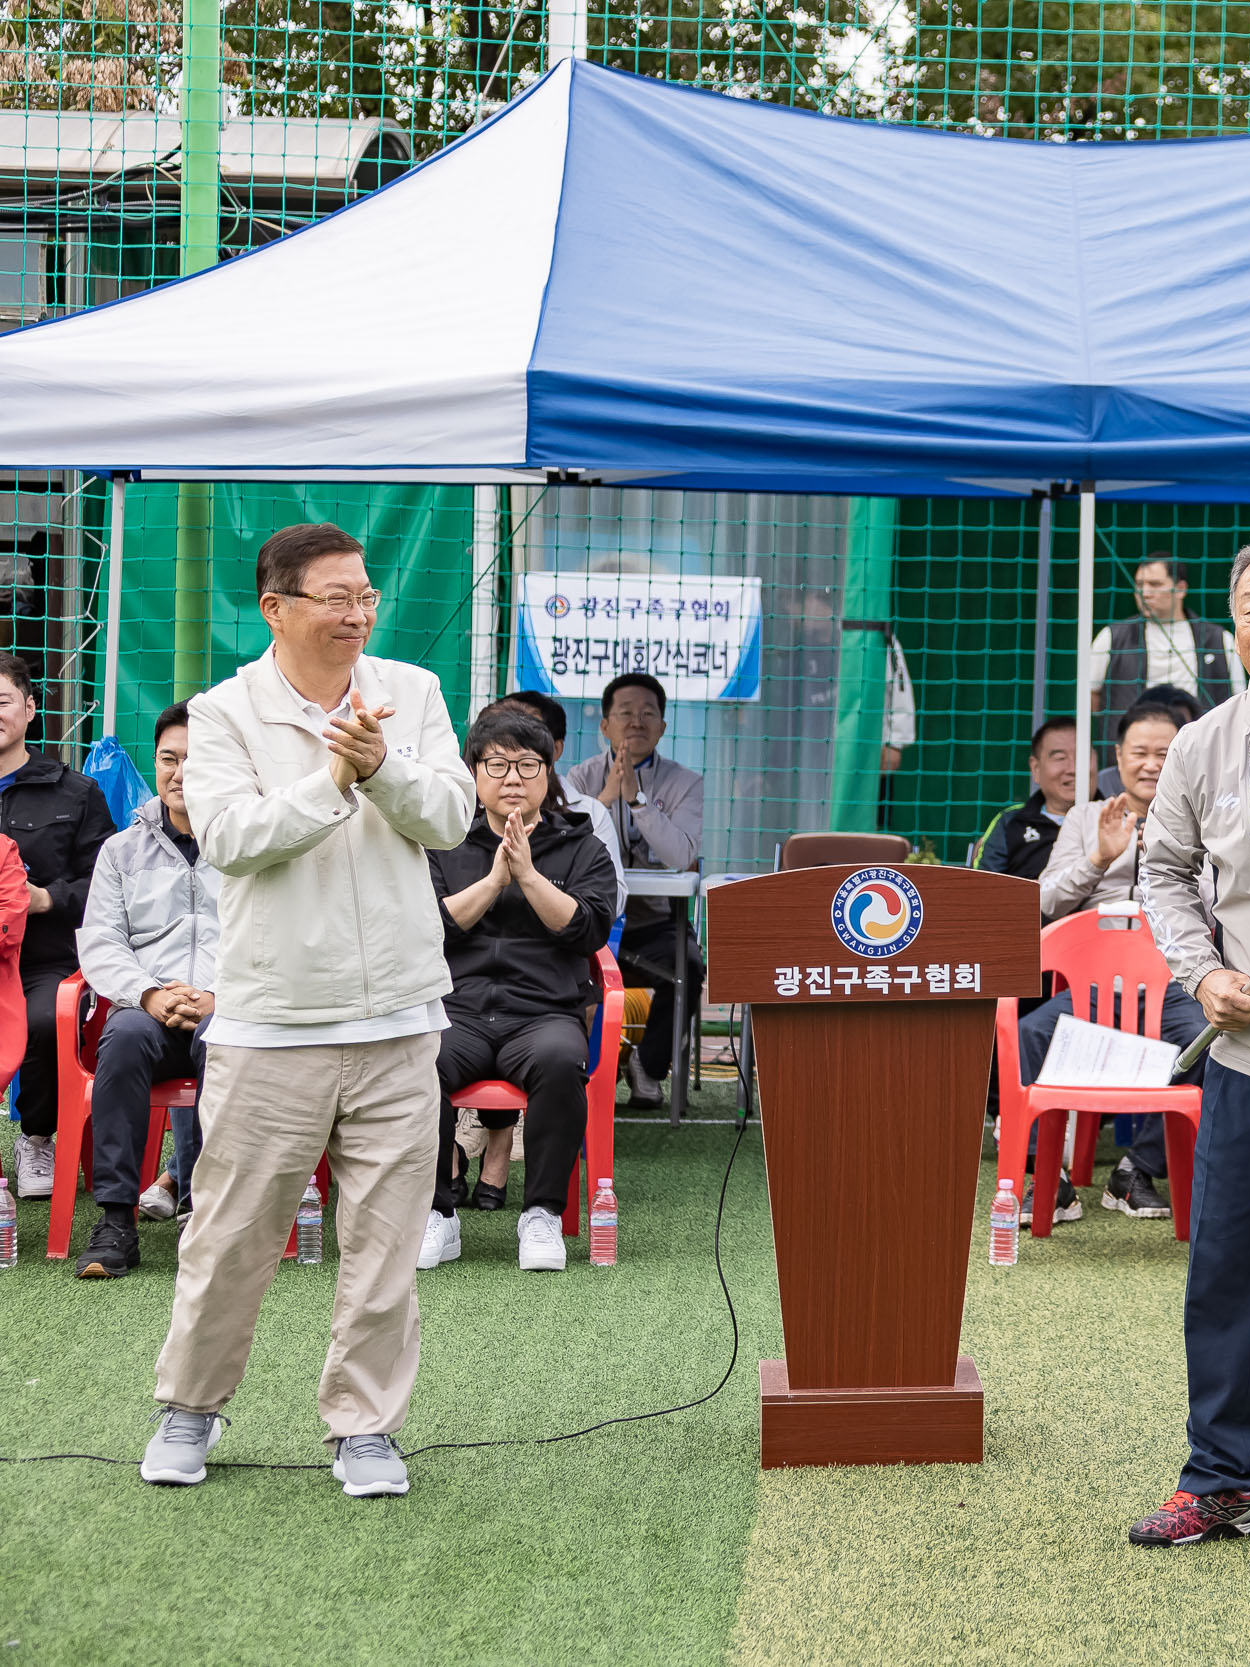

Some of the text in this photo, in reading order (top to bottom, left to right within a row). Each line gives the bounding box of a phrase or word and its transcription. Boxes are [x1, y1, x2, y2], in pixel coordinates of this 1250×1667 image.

[579, 596, 730, 622] 광진구족구협회
[551, 636, 729, 678] 광진구대회간식코너
[835, 870, 920, 907] 서울특별시광진구족구협회
[837, 922, 917, 955] GWANGJIN-GU
[774, 962, 982, 996] 광진구족구협회
